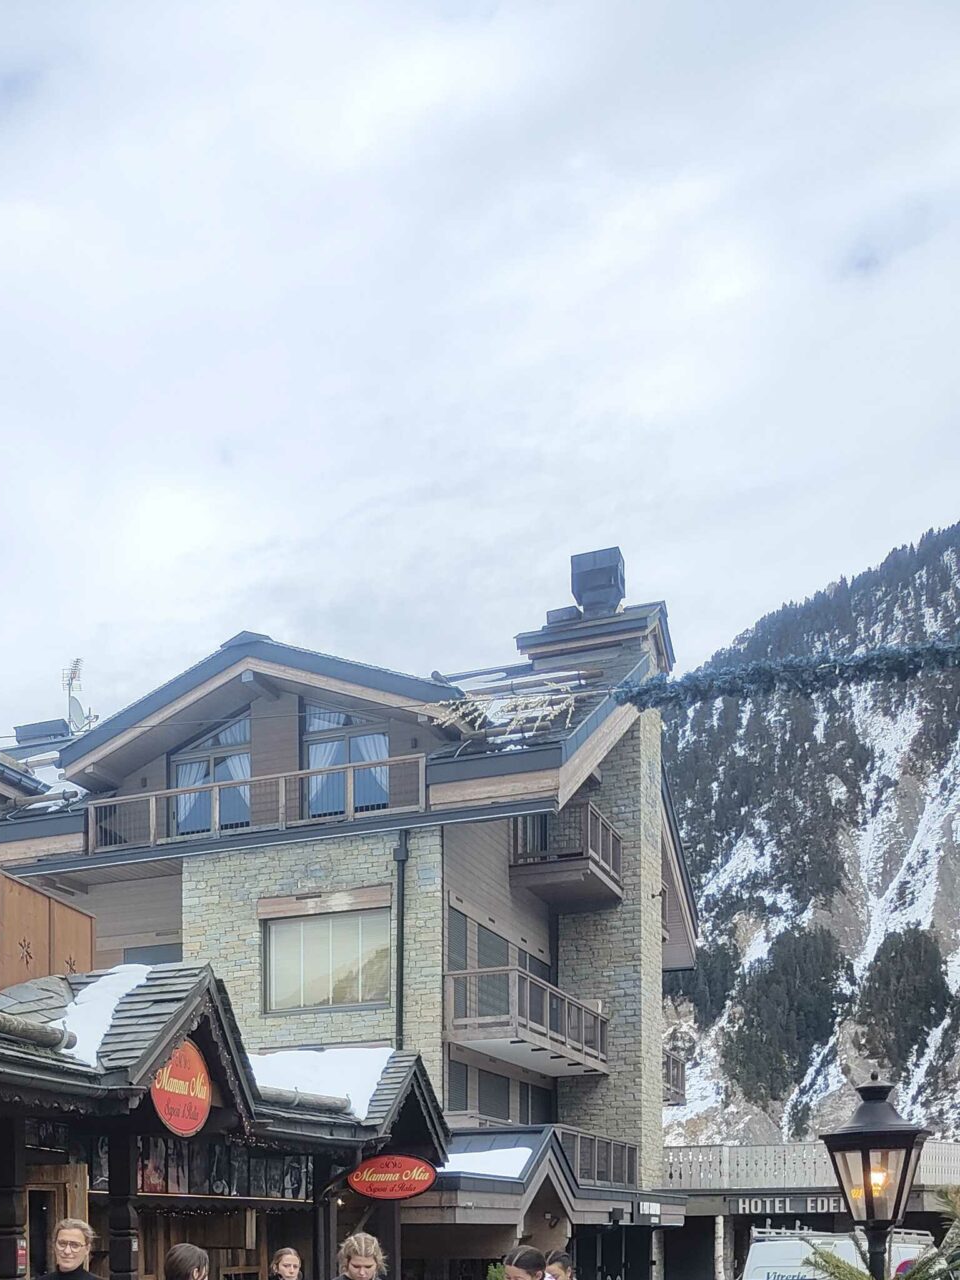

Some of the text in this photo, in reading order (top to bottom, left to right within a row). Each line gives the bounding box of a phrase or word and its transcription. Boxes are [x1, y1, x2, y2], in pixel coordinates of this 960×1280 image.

[155, 1064, 207, 1099] Mamma Mia
[353, 1166, 430, 1182] Mamma Mia
[738, 1197, 795, 1214] HOTEL
